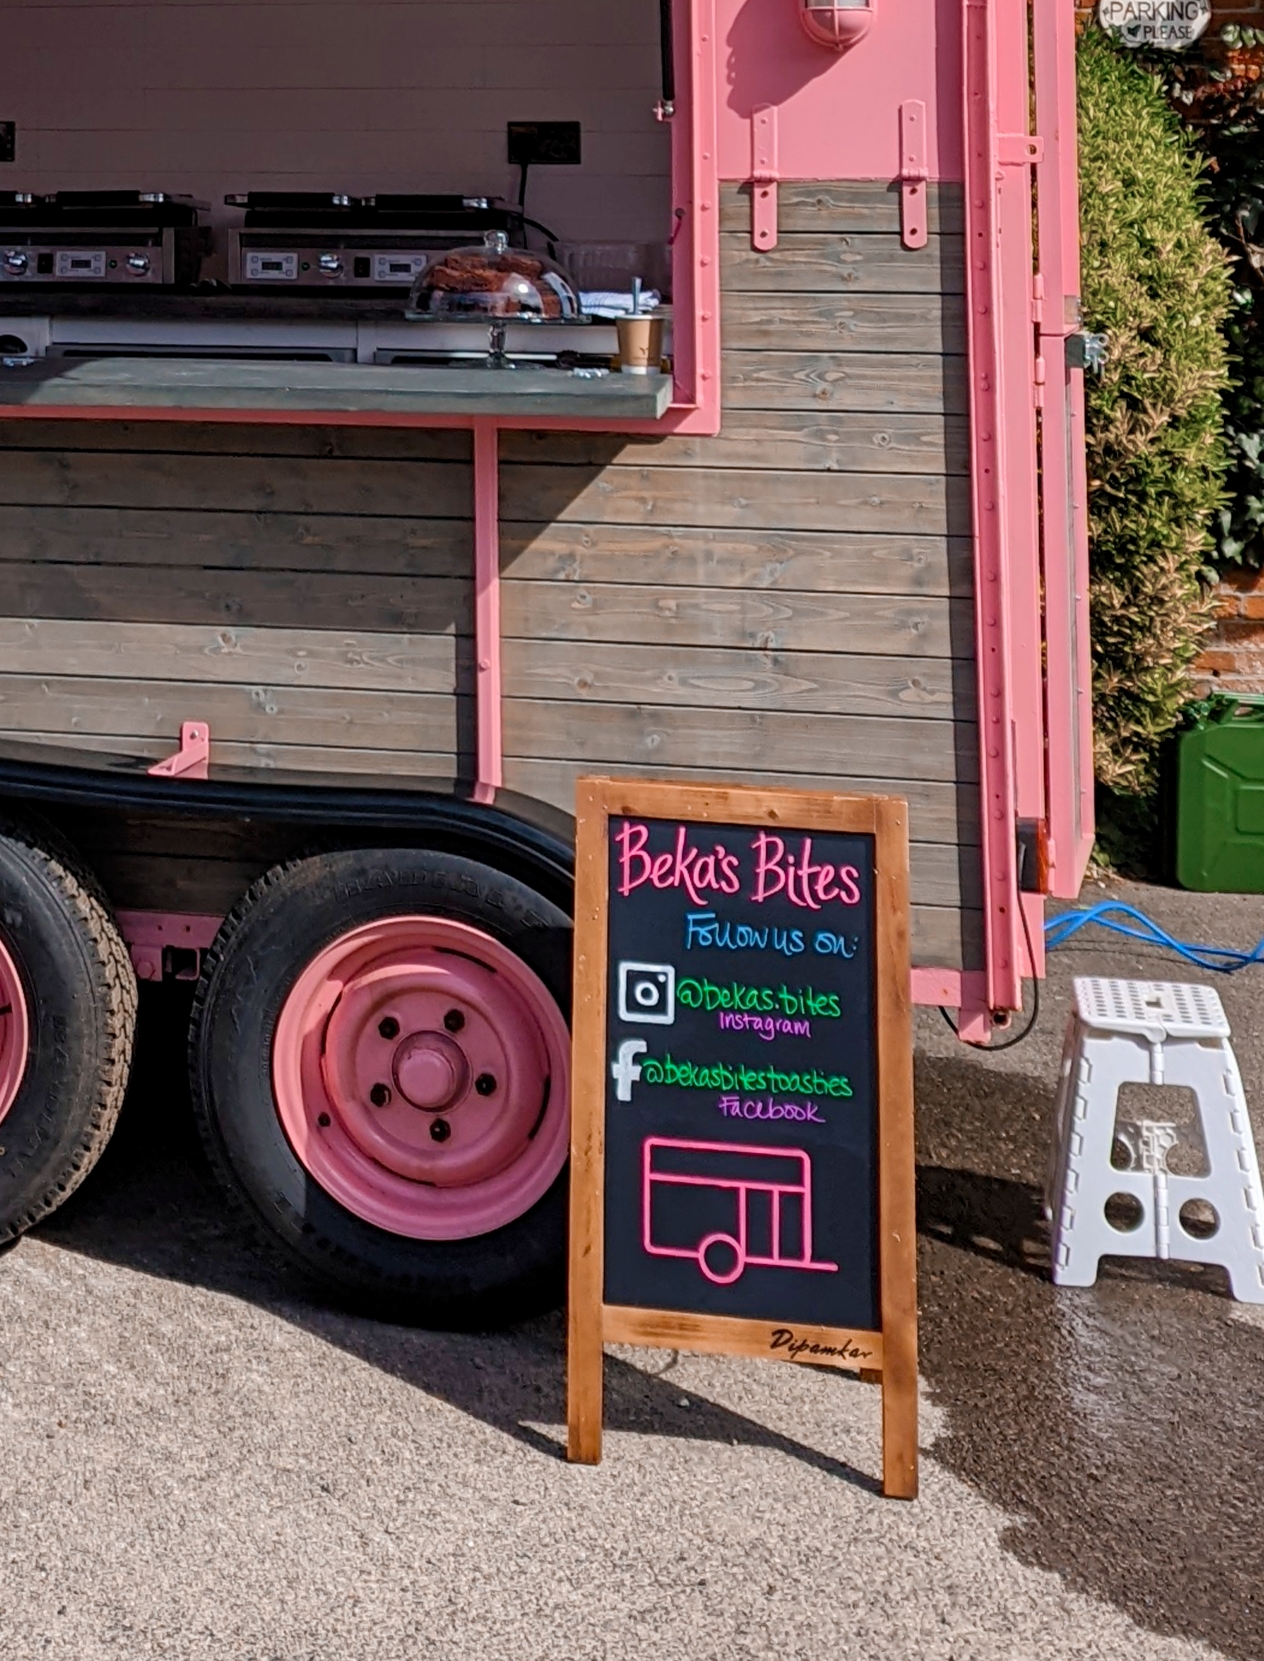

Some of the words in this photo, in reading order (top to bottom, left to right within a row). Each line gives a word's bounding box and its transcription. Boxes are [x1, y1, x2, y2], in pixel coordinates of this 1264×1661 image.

[1109, 1, 1199, 21] PARKING
[1143, 25, 1192, 40] PLEASE
[615, 821, 741, 906] Beka's
[750, 830, 861, 910] Bites
[686, 911, 768, 950] Follow
[773, 928, 805, 956] us
[676, 977, 842, 1017] @bekas.bites
[719, 1011, 812, 1041] Instagram
[643, 1054, 854, 1097] @bekasbitestoasties
[718, 1096, 827, 1123] Facebook
[770, 1328, 873, 1360] Dipamkar
